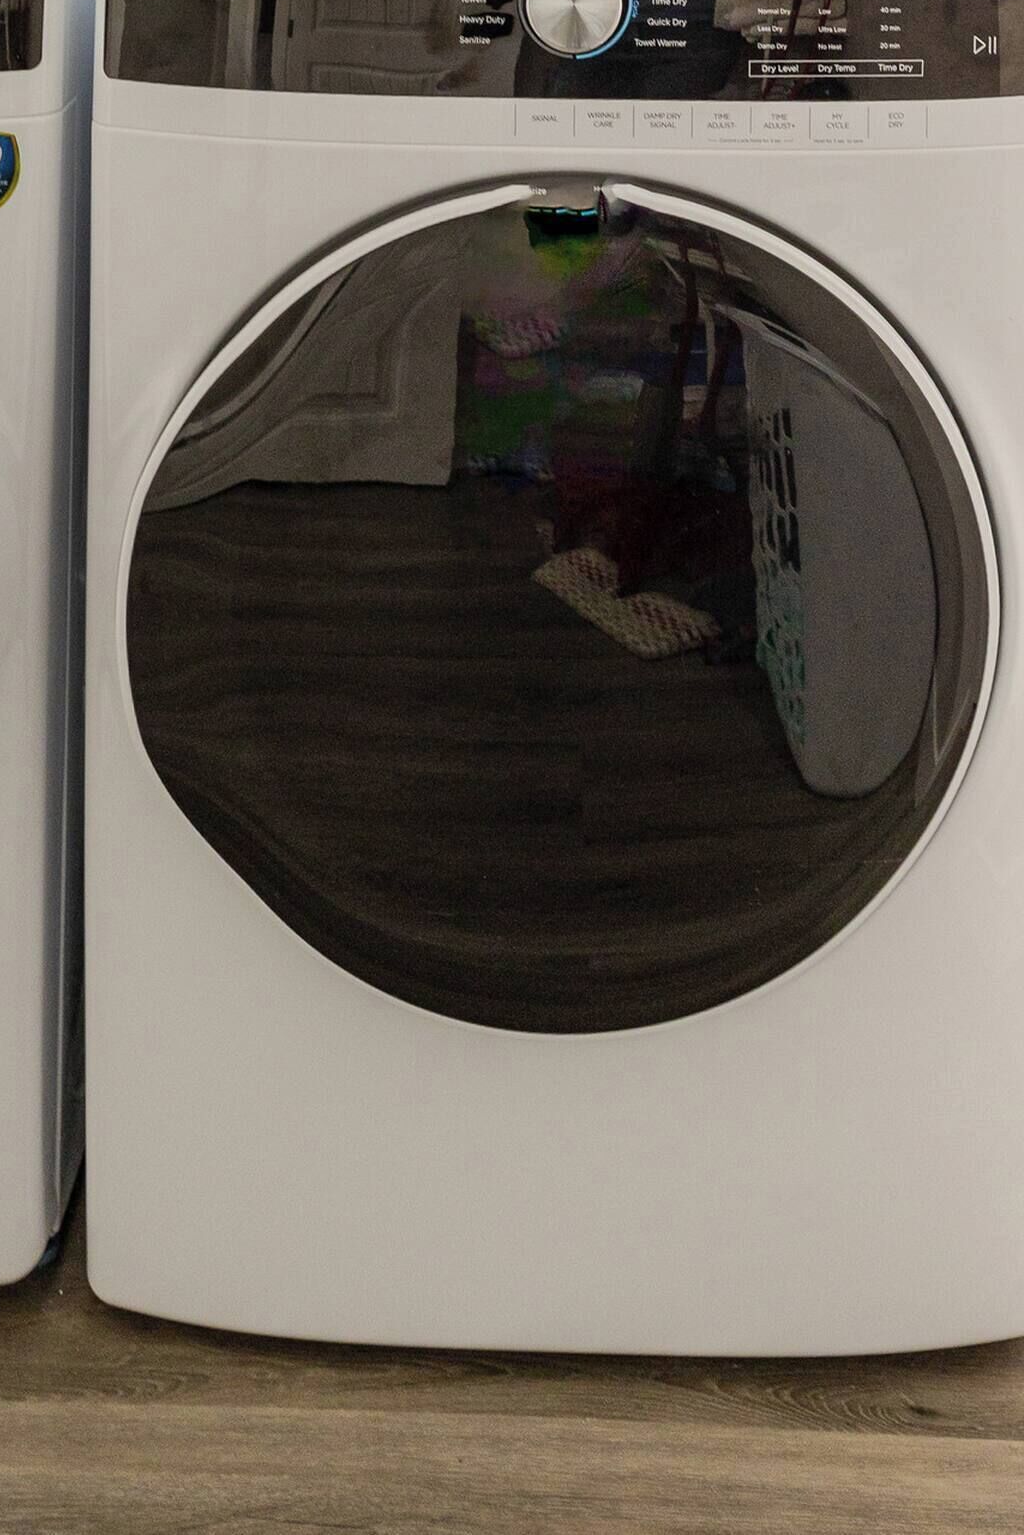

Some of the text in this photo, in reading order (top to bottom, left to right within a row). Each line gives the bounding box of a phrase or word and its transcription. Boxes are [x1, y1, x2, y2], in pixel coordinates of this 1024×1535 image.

[778, 8, 791, 16] Dry
[459, 15, 506, 25] Heavy Duty
[647, 18, 687, 28] Quick Dry
[459, 36, 491, 44] Sanitize
[634, 38, 687, 48] Towel Warmer
[776, 43, 787, 51] Dry
[761, 64, 799, 74] Dry Level
[818, 64, 856, 74] Dry Temp
[878, 63, 913, 73] Time Dry
[587, 112, 621, 120] WRINKLE
[644, 112, 681, 120] DAMP DRY
[593, 120, 614, 128] CARE
[826, 122, 849, 130] CYCLE
